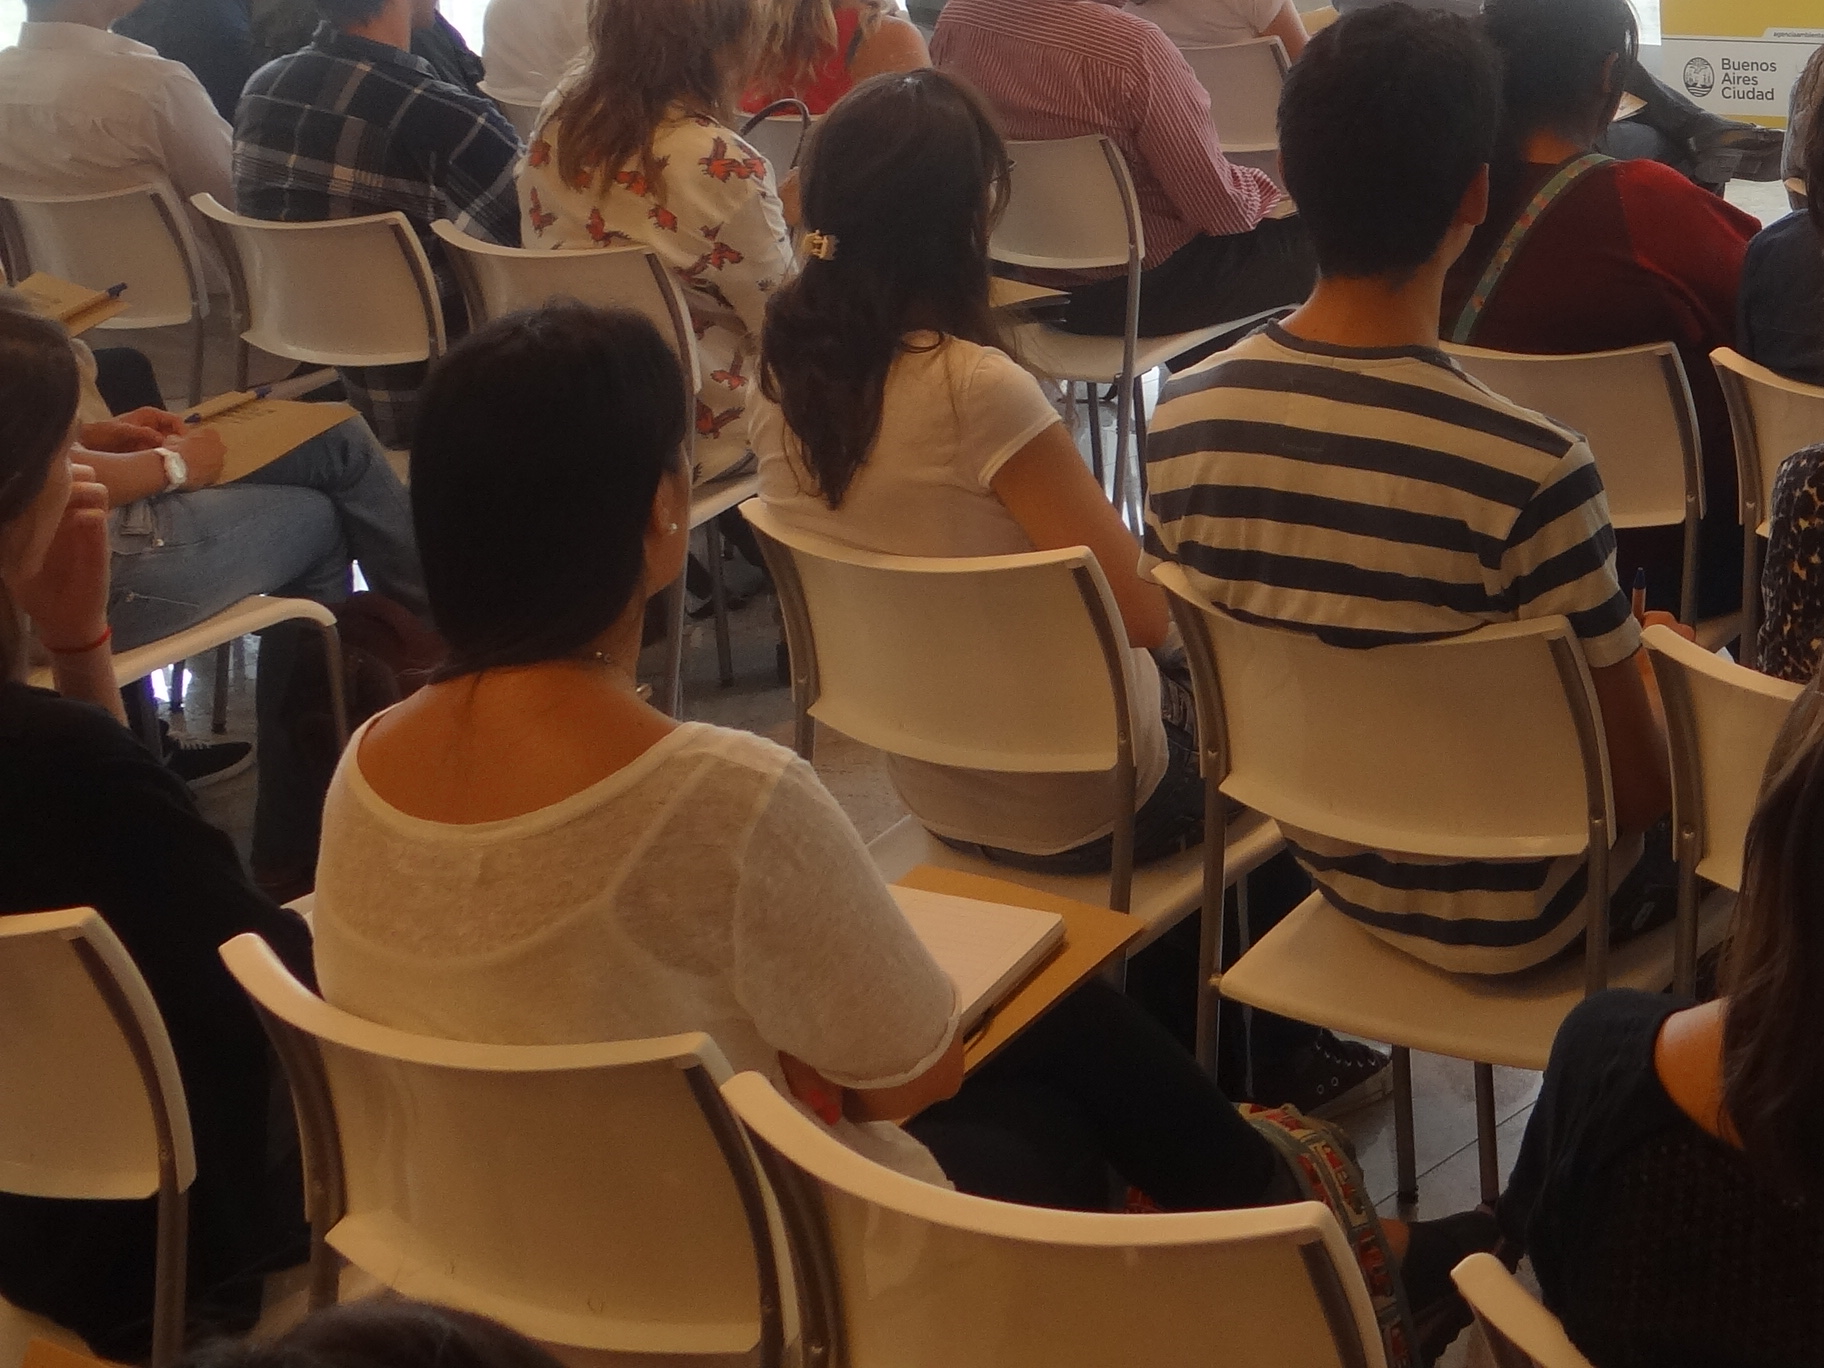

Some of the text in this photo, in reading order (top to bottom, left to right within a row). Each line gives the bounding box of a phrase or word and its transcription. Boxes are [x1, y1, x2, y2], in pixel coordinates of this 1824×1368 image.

[1721, 58, 1777, 72] Buenos
[1721, 72, 1759, 86] Aires
[1721, 86, 1775, 101] Ciudad
